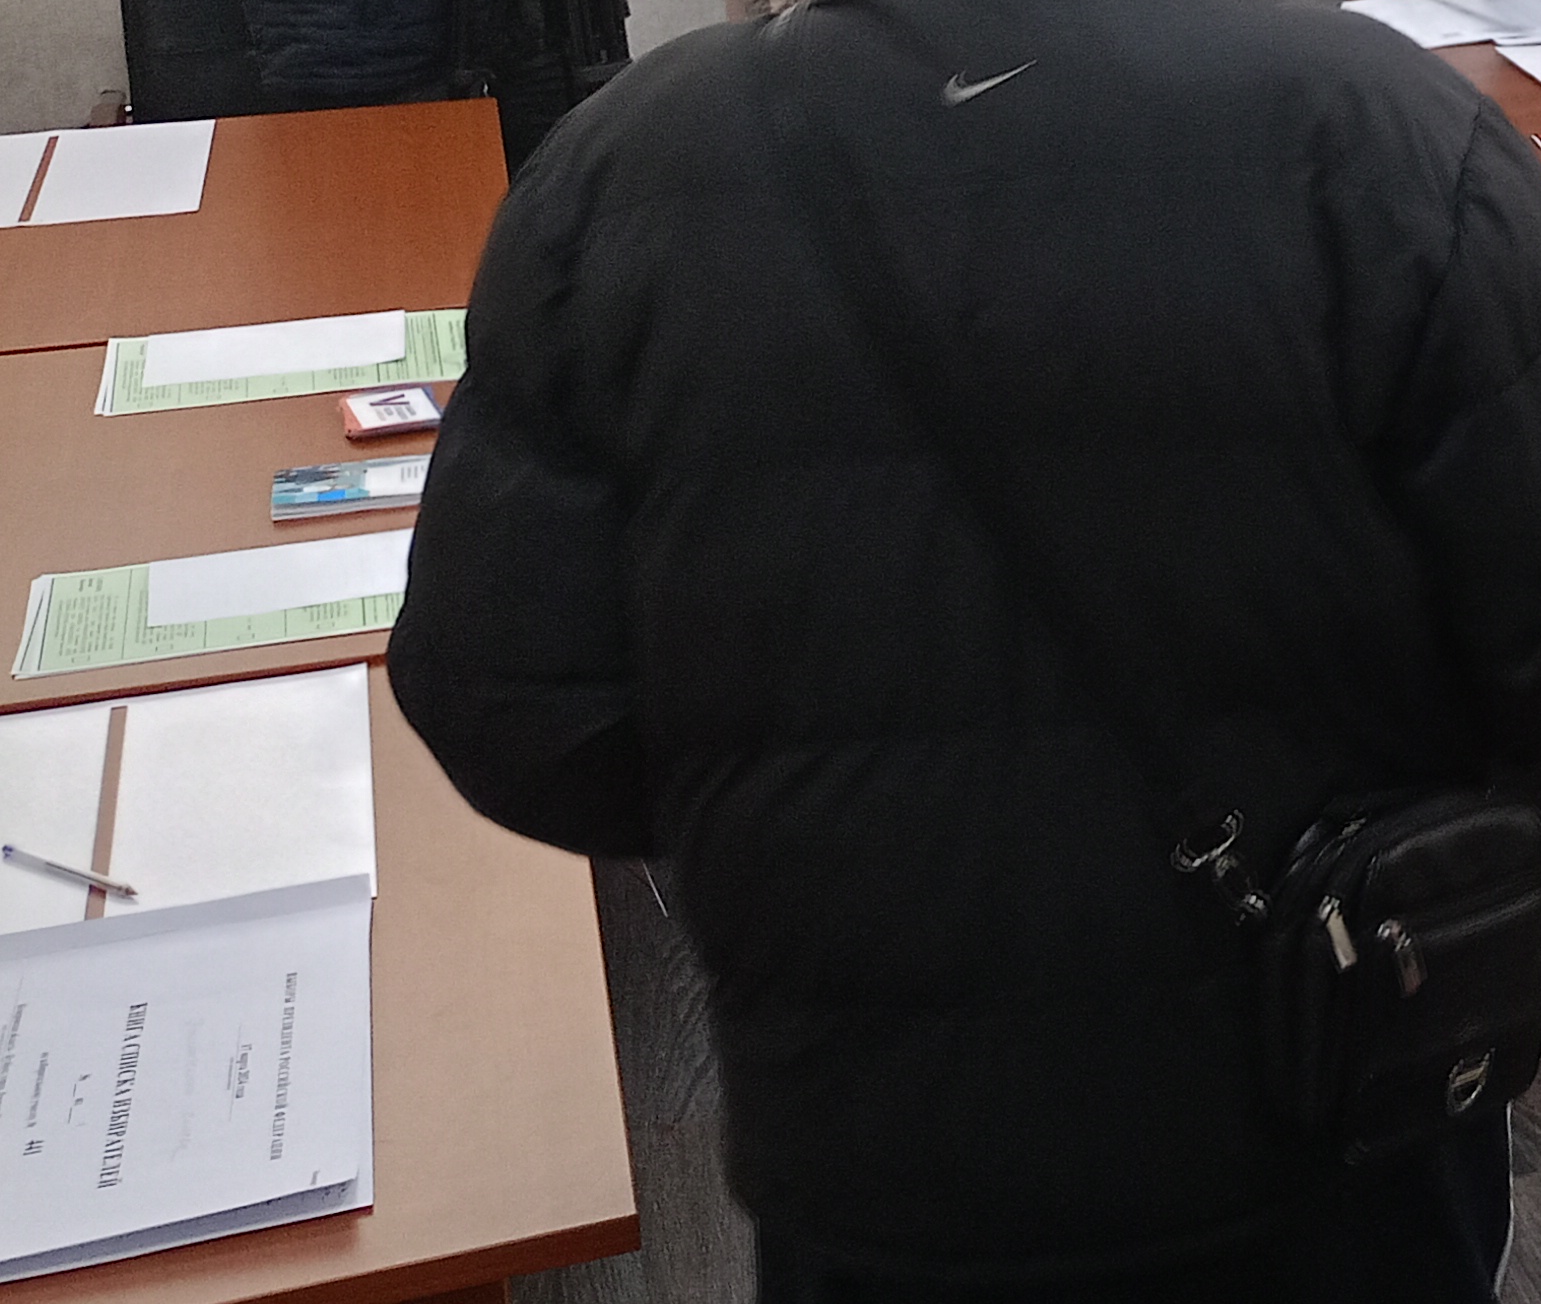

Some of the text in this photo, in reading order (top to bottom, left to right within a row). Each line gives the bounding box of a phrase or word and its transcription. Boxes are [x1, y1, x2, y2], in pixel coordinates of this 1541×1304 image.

[97, 1002, 148, 1189] КНИГА СПИСКА ИЗБИРАТЕЛЕЙ
